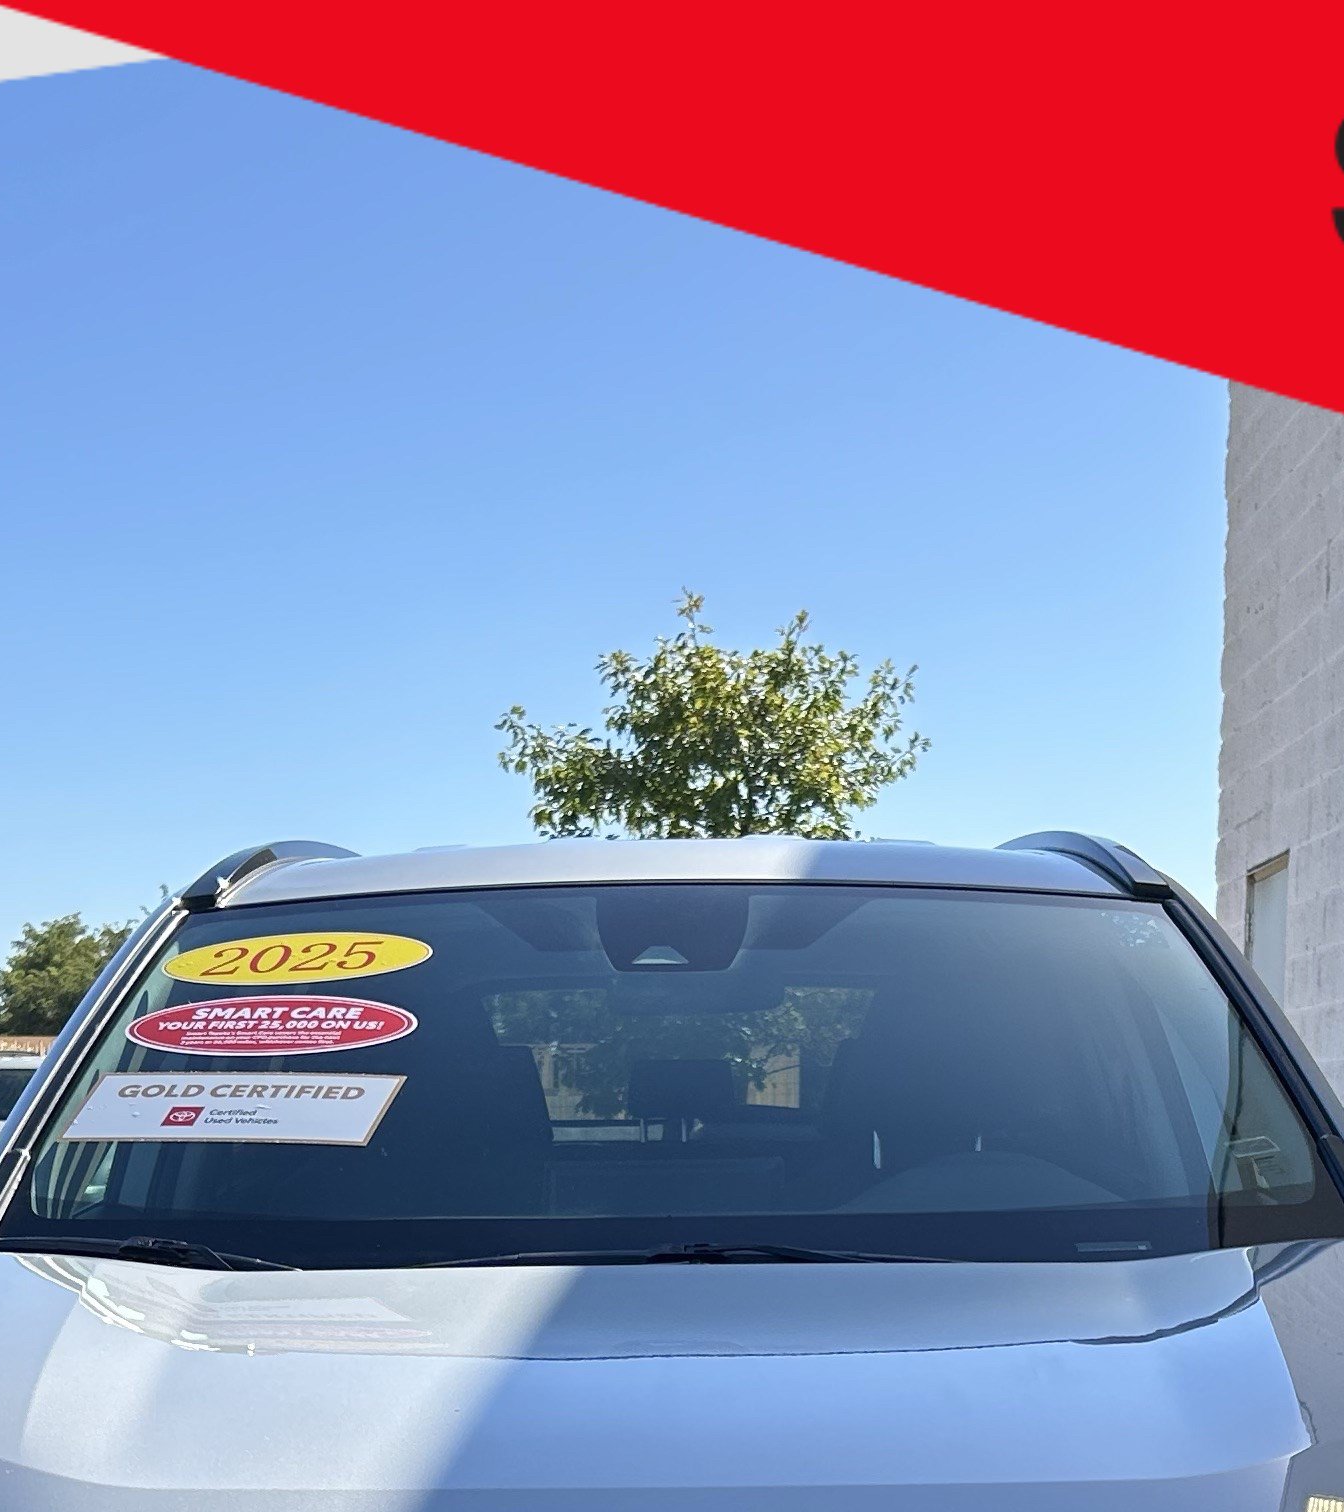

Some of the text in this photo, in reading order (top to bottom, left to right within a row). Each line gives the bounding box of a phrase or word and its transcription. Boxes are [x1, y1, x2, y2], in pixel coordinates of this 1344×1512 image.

[199, 940, 385, 977] 2025
[191, 1007, 365, 1020] SMART CARE
[158, 1020, 207, 1031] YOUR
[208, 1020, 258, 1030] FIRST
[320, 1020, 352, 1030] ON
[353, 1020, 385, 1030] US!
[117, 1084, 366, 1100] GOLD CERTIFIED
[209, 1108, 257, 1117] Certified
[204, 1117, 233, 1125] Used
